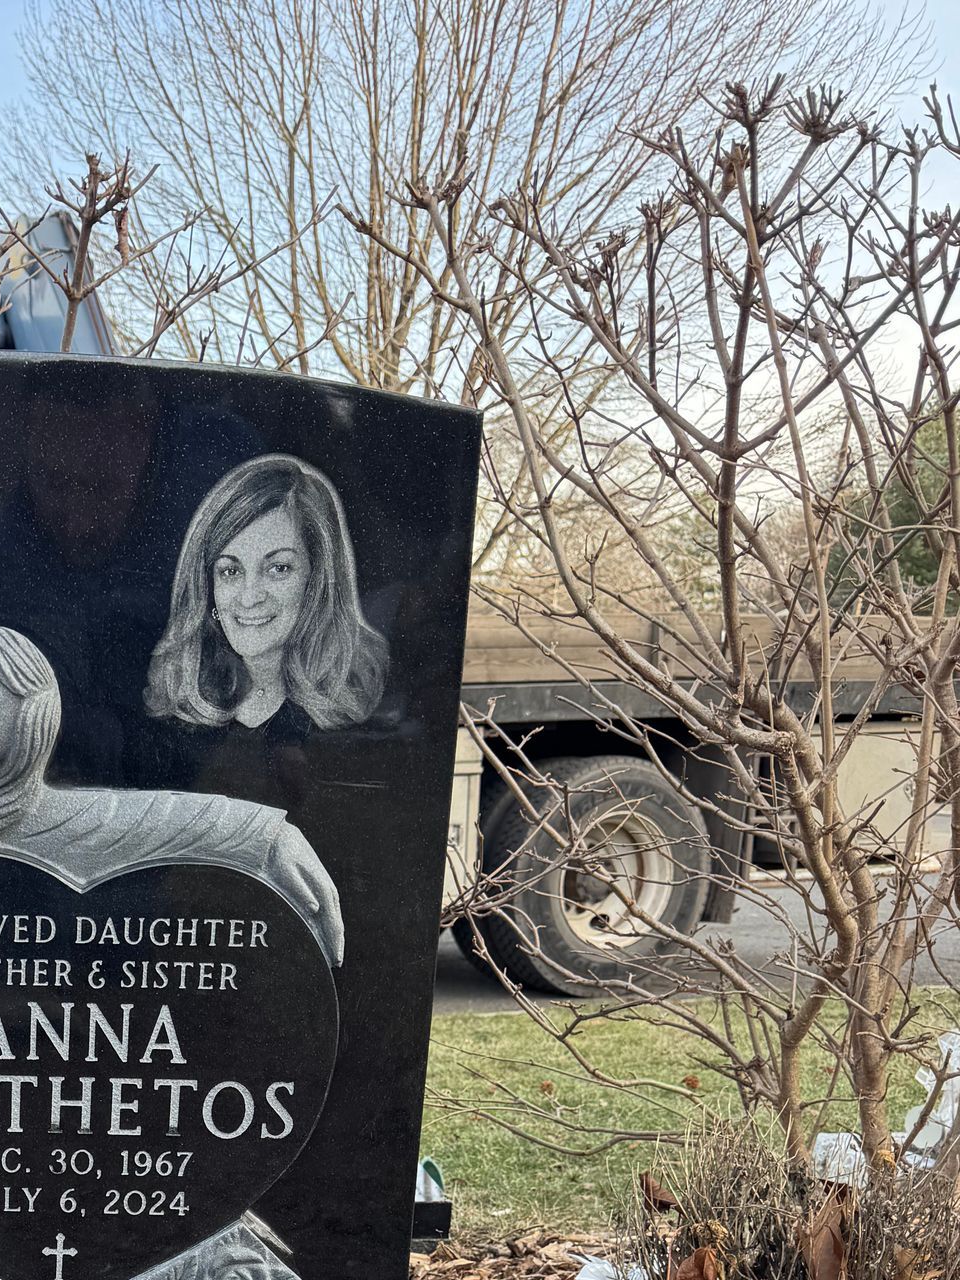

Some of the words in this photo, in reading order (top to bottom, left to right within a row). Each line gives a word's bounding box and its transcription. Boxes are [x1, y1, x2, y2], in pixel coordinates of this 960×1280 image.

[75, 917, 268, 947] DAUGHTER
[88, 961, 105, 989] &
[121, 961, 237, 990] SISTER
[49, 1149, 101, 1179] 30,
[121, 1151, 193, 1176] 1967
[60, 1189, 85, 1217] 6,
[104, 1190, 189, 1216] 2024
